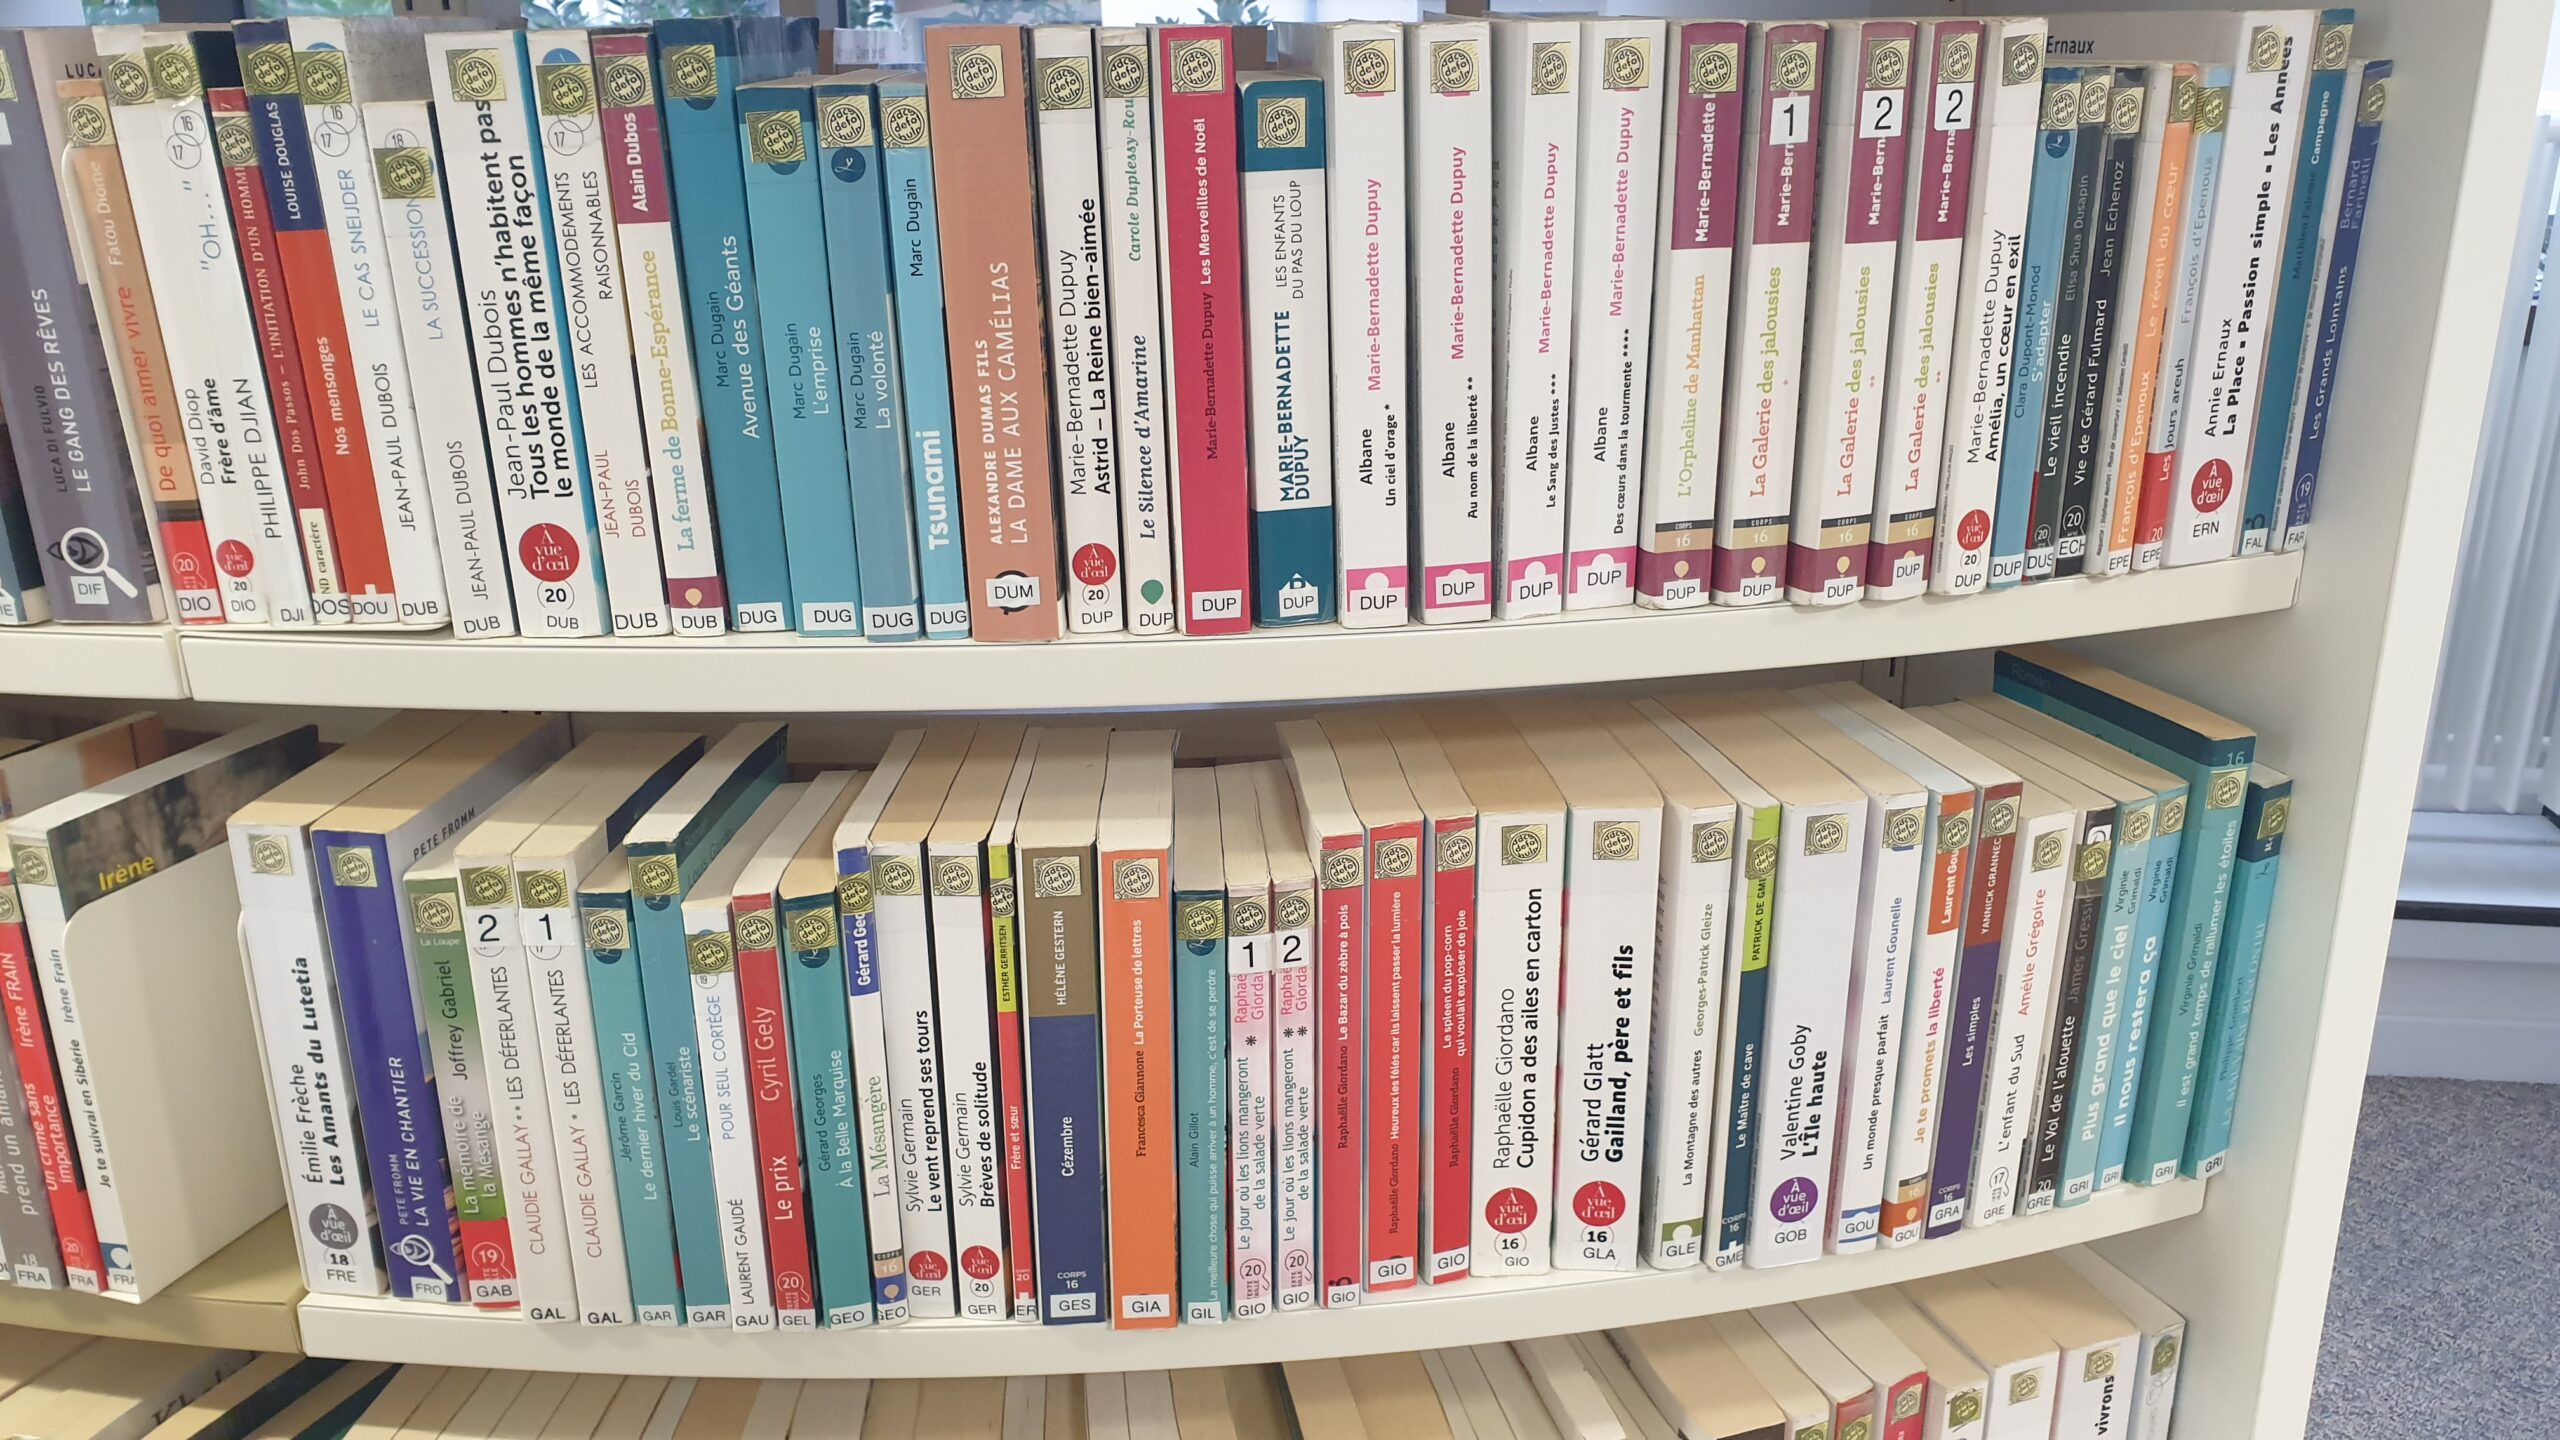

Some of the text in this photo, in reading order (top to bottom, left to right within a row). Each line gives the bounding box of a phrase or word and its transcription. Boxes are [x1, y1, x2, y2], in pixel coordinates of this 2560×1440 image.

[266, 102, 301, 220] LOUISE DOUGLAS
[622, 112, 649, 212] Alain Dubos
[1783, 103, 1794, 136] 1
[1874, 96, 1893, 131] 2
[1945, 89, 1963, 123] 2
[2263, 122, 2280, 157] Les
[337, 169, 380, 327] LE CAS SNEIJDER
[1078, 198, 1101, 320] bien-aimée
[2249, 181, 2271, 249] simple
[470, 99, 550, 500] Tous les hommes n'habitent pas
[508, 155, 574, 498] le monde de la même façon
[721, 235, 760, 439] Avenue des Géants
[1365, 178, 1382, 391] Marie-Bernadette Dupuy
[2237, 257, 2260, 333] Passion
[31, 288, 92, 492] LE GANG DES RÊVES
[115, 286, 177, 491] De quoi aimer vivre
[316, 336, 350, 455] Nos mensonges
[480, 289, 528, 500] Jean-Paul Dubois
[642, 250, 695, 551] La ferme de Bonne-Espérance
[989, 262, 1028, 544] LA DAME AUX CAMÉLIAS
[1059, 249, 1087, 495] Marie-Bernadette Dupuy
[1086, 325, 1105, 382] Reine
[1089, 389, 1106, 411] La
[1749, 267, 1781, 498] La Galerie des jalousies
[1966, 229, 2007, 463] Marie-Bernadette Dupuy
[1984, 234, 2021, 462] Amélia, un cœur en exil
[2073, 299, 2107, 486] Vie de Gérard Fulmard
[2204, 318, 2232, 437] Annie Ernaux
[2226, 356, 2245, 407] Place
[184, 388, 215, 485] David Diop
[204, 378, 237, 484] Frère d'âme
[372, 363, 416, 532] JEAN-PAUL DUBOIS
[975, 339, 1003, 545] ALEXANDRE DUMAS FILS
[1091, 437, 1111, 495] Astrid
[1358, 429, 1373, 485] Albane
[1384, 414, 1398, 507] Un ciel d'orage
[2222, 413, 2237, 436] La
[917, 427, 949, 551] Tsunami
[2192, 521, 2219, 537] ERN
[77, 582, 102, 596] DIF
[994, 584, 1034, 600] DUM
[1053, 910, 1067, 1006] HÉLÈNE GESTERN
[1131, 919, 1144, 1045] La Porteuse de lettres
[295, 957, 345, 1186] Les Amants du Lutetia
[490, 966, 524, 1100] LES DÉFERLANTES
[752, 1006, 783, 1101] Cyril Gely
[1492, 988, 1515, 1169] Raphaëlle Giordano
[1516, 888, 1542, 1169] Cupidon a des ailes en carton
[1605, 945, 1634, 1163] Gailland, père et fils
[1962, 996, 1981, 1066] Les simples
[289, 1064, 324, 1184] Émilie Frèche
[388, 1056, 430, 1227] LA VIE EN CHANTIER
[955, 1092, 977, 1207] Sylvie Germain
[972, 1061, 995, 1208] Brèves de solitude
[1060, 1116, 1075, 1177] Cézembre
[1580, 1043, 1604, 1162] Gérard Glatt
[1780, 1024, 1812, 1161] Valentine Goby
[1802, 1050, 1828, 1157] L'Île haute
[1862, 1014, 1889, 1170] Un monde presque parfait
[512, 1124, 546, 1255] CLAUDIE GALLAY
[768, 1156, 794, 1220] Le prix
[1774, 1228, 1807, 1244] GOB
[1058, 1299, 1091, 1311] GES
[1132, 1300, 1161, 1313] GIA
